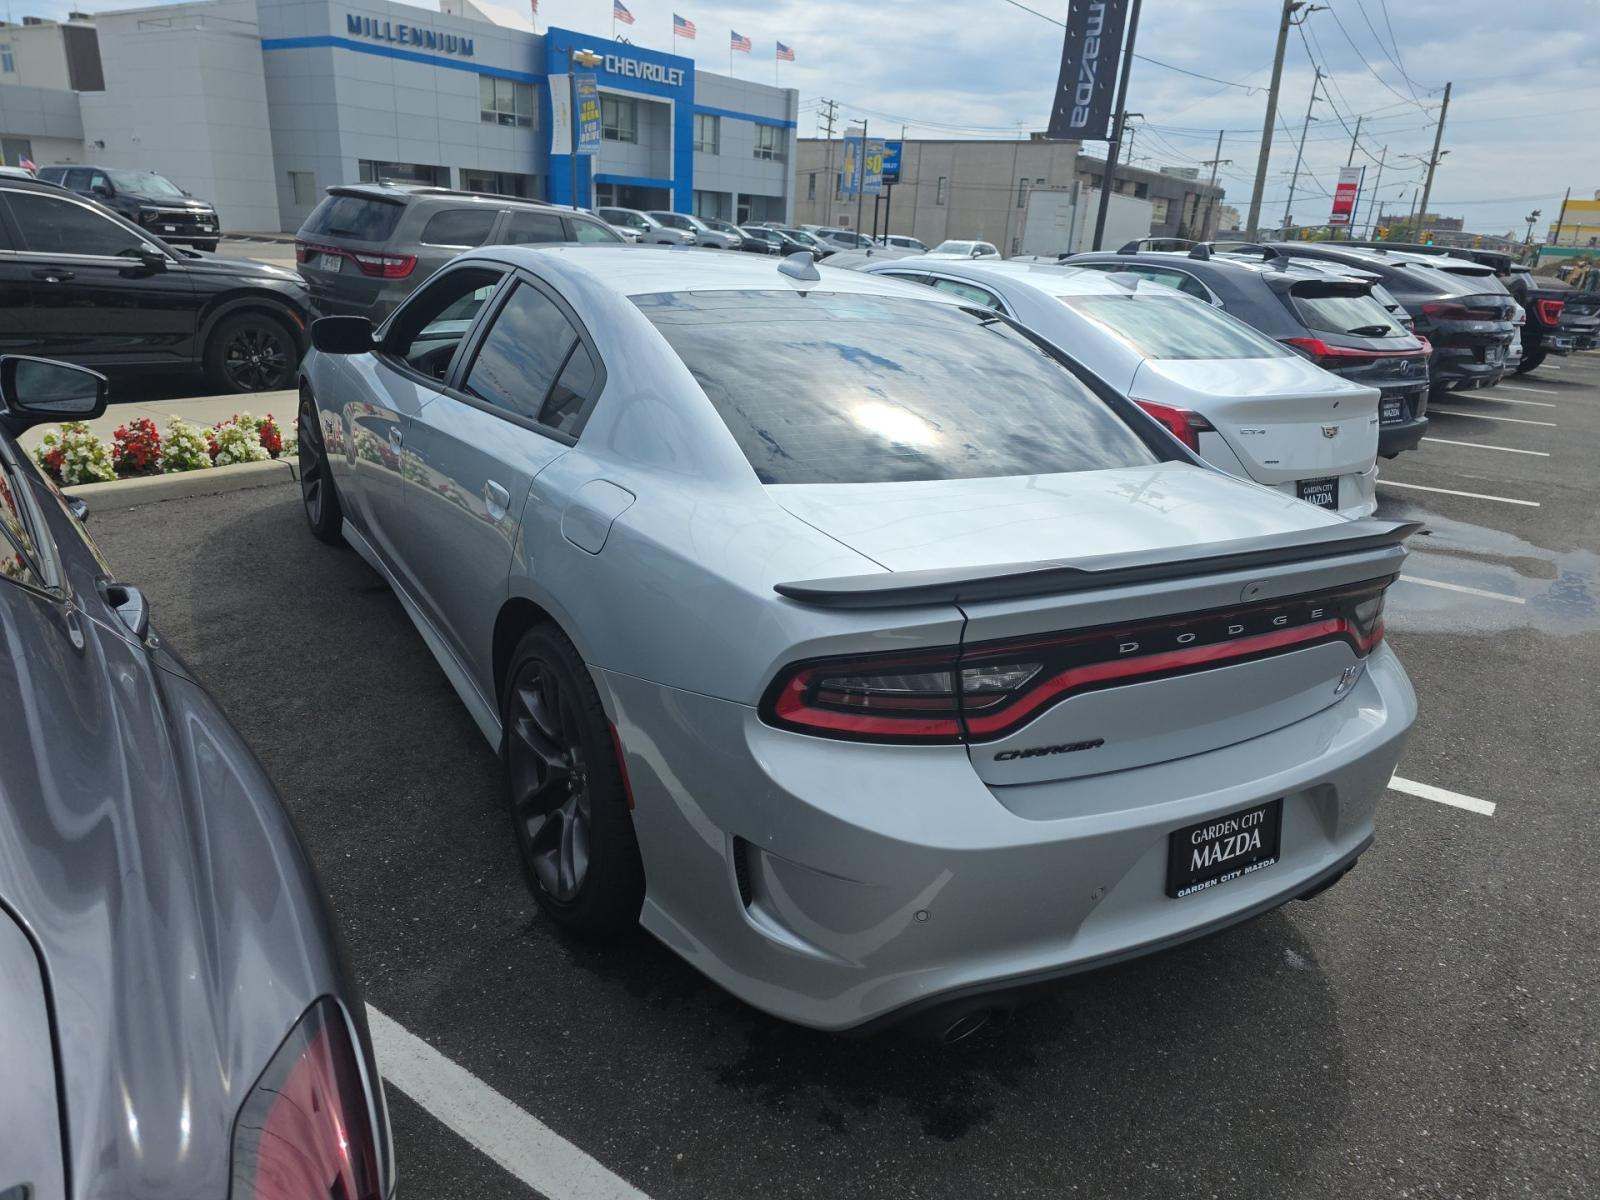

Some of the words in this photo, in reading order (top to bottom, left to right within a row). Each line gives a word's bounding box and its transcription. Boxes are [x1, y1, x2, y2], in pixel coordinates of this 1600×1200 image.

[346, 13, 474, 56] MILLENNIUM
[605, 54, 685, 87] CHEVROLET
[1070, 3, 1106, 128] mazda
[1304, 491, 1333, 505] MAZDA
[1119, 608, 1323, 655] DODGE
[994, 737, 1105, 762] CHARGER
[1191, 818, 1240, 845] GARDEN
[1241, 809, 1266, 828] CITY
[1190, 828, 1262, 872] MAZDA
[1177, 878, 1218, 897] GARDEN
[1220, 870, 1242, 883] CITY
[1244, 858, 1275, 874] MAZDA
